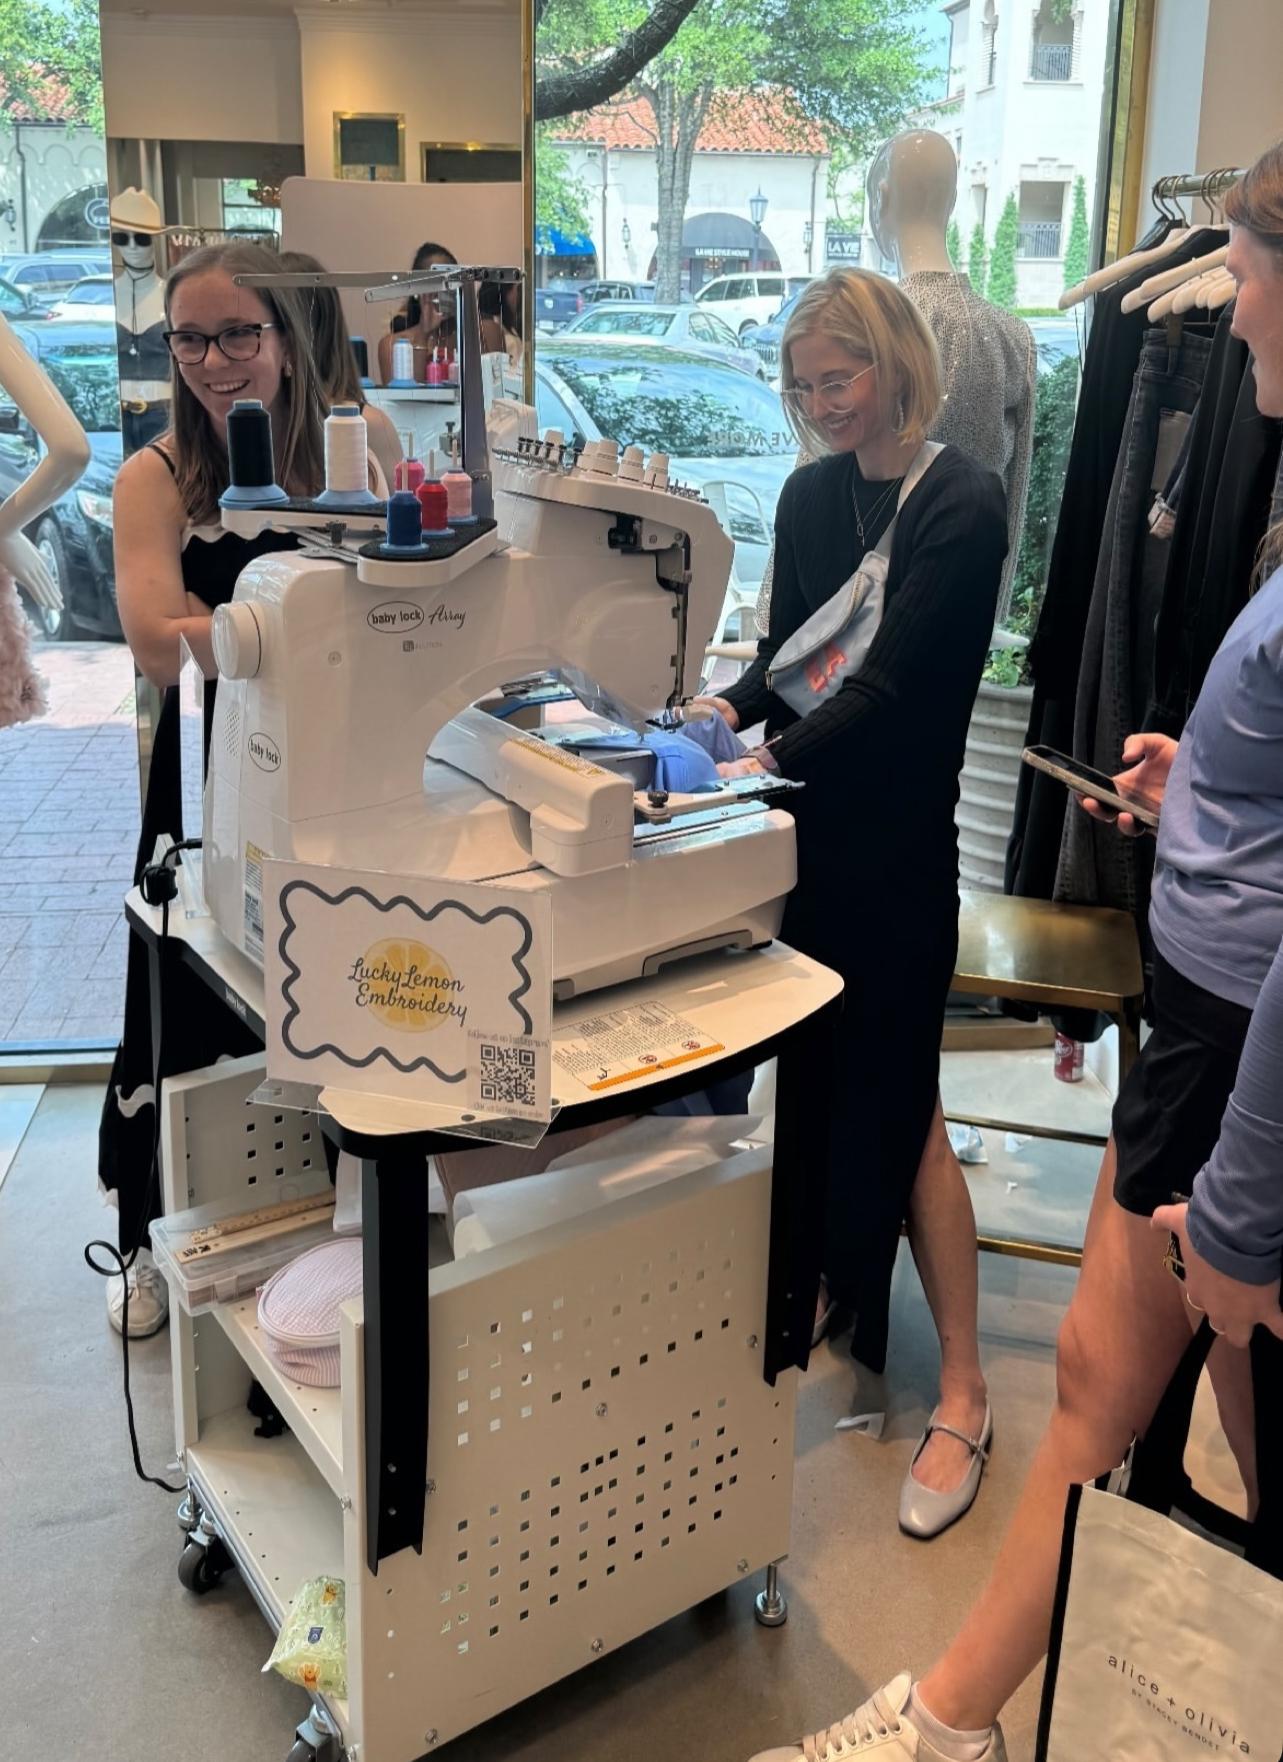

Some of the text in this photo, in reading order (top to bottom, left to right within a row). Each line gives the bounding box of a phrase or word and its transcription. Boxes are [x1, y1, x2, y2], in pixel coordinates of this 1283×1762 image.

[828, 241, 860, 253] LA VIE
[371, 604, 467, 630] baby lock Array
[250, 738, 279, 765] baby lock
[355, 982, 467, 1028] Embroidery
[1108, 1655, 1250, 1754] alice + olivia
